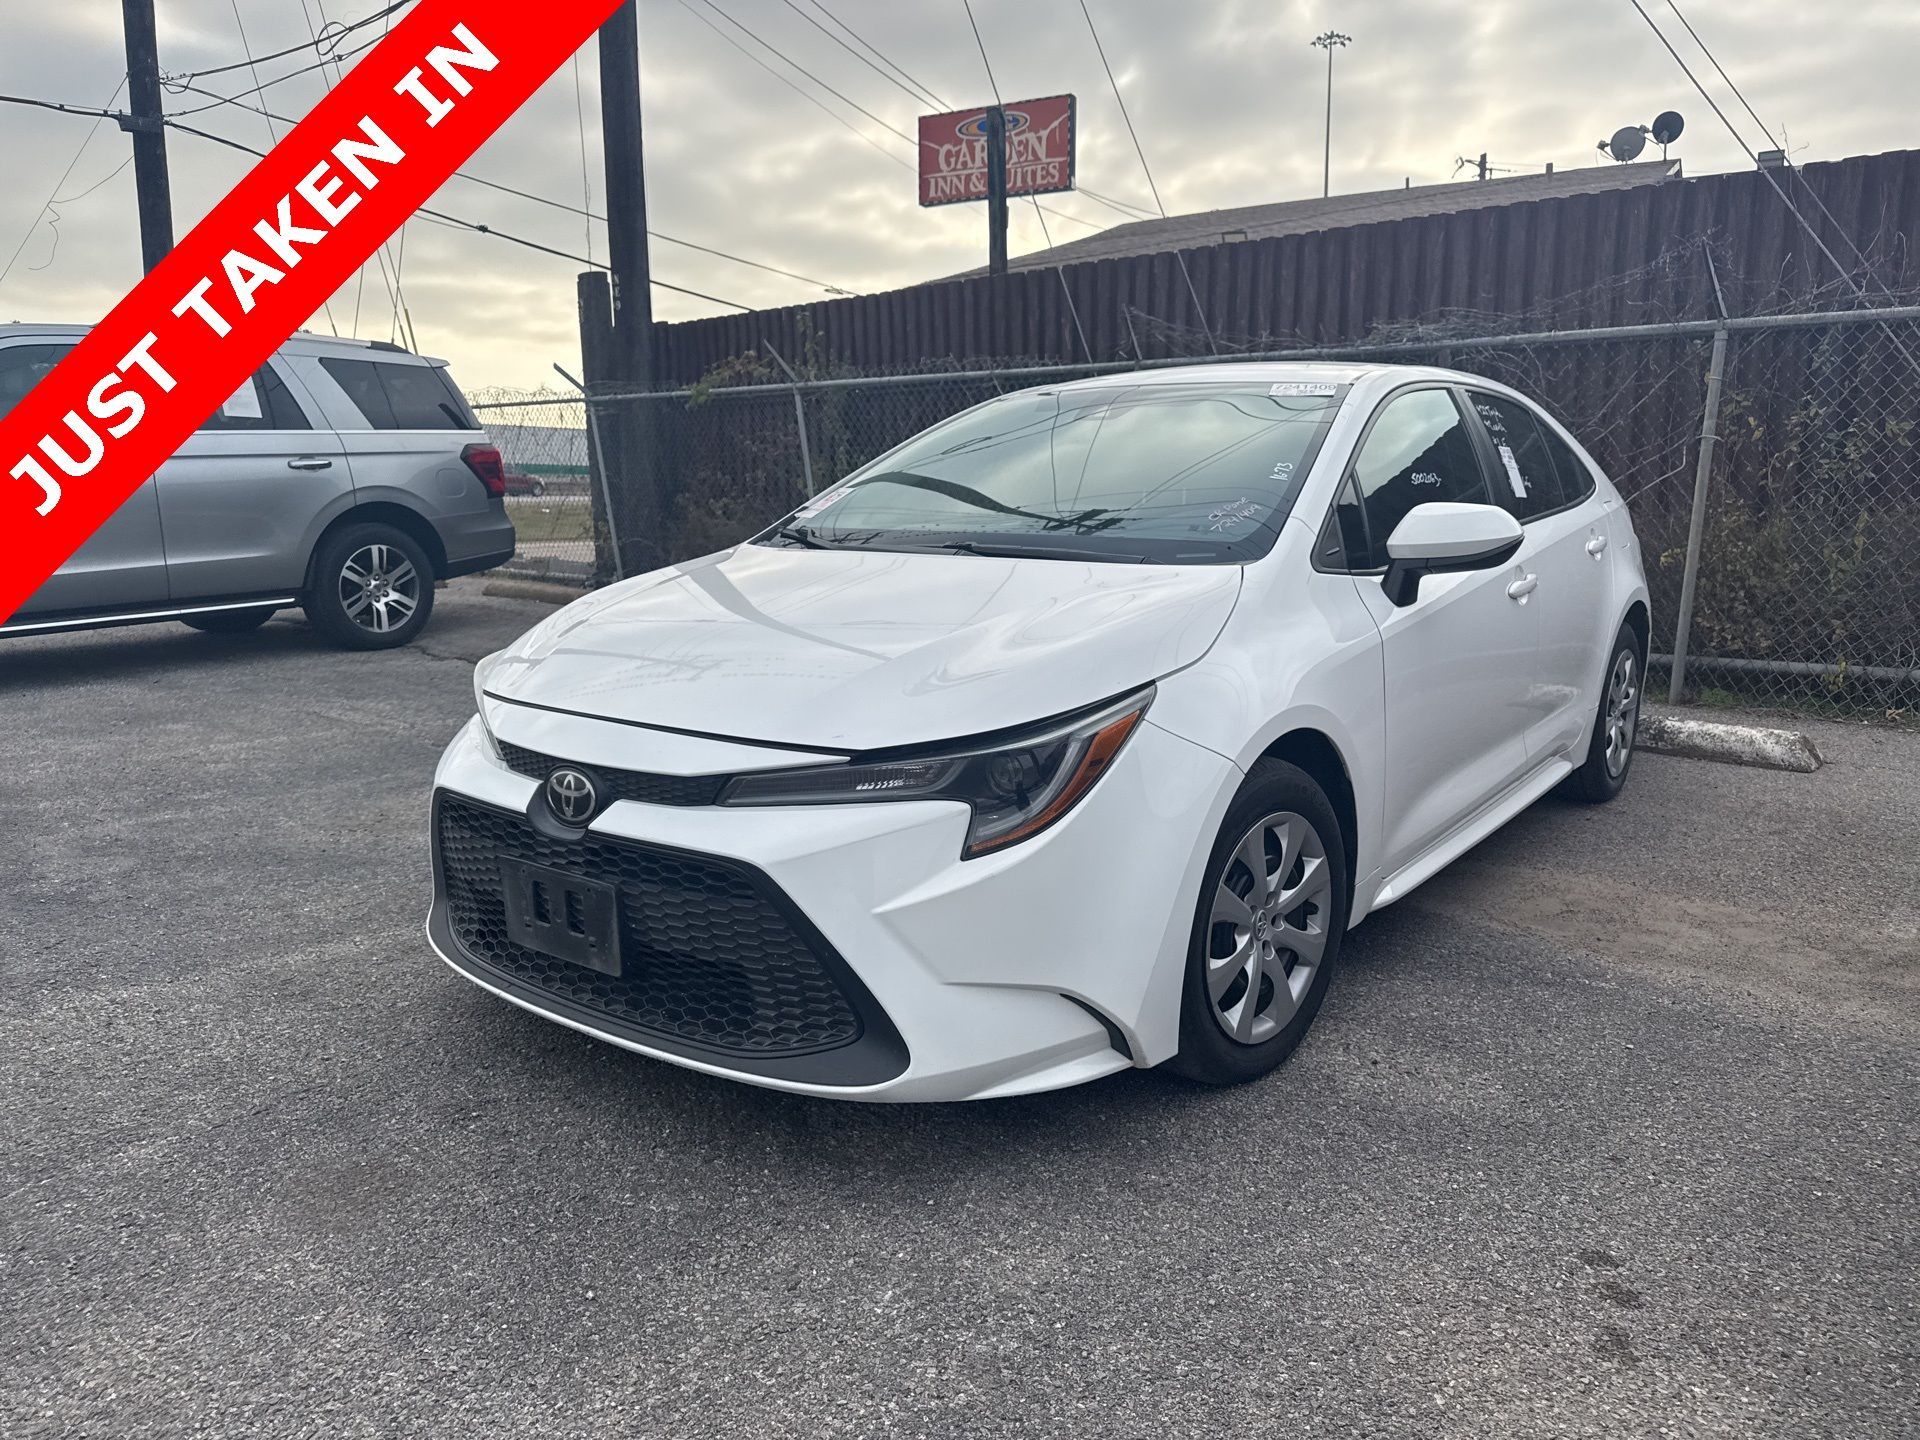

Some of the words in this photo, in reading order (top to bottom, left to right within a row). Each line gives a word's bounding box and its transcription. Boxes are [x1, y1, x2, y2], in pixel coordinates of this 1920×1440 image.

[928, 173, 965, 199] INN
[969, 172, 986, 192] &
[1004, 163, 1060, 189] UITES
